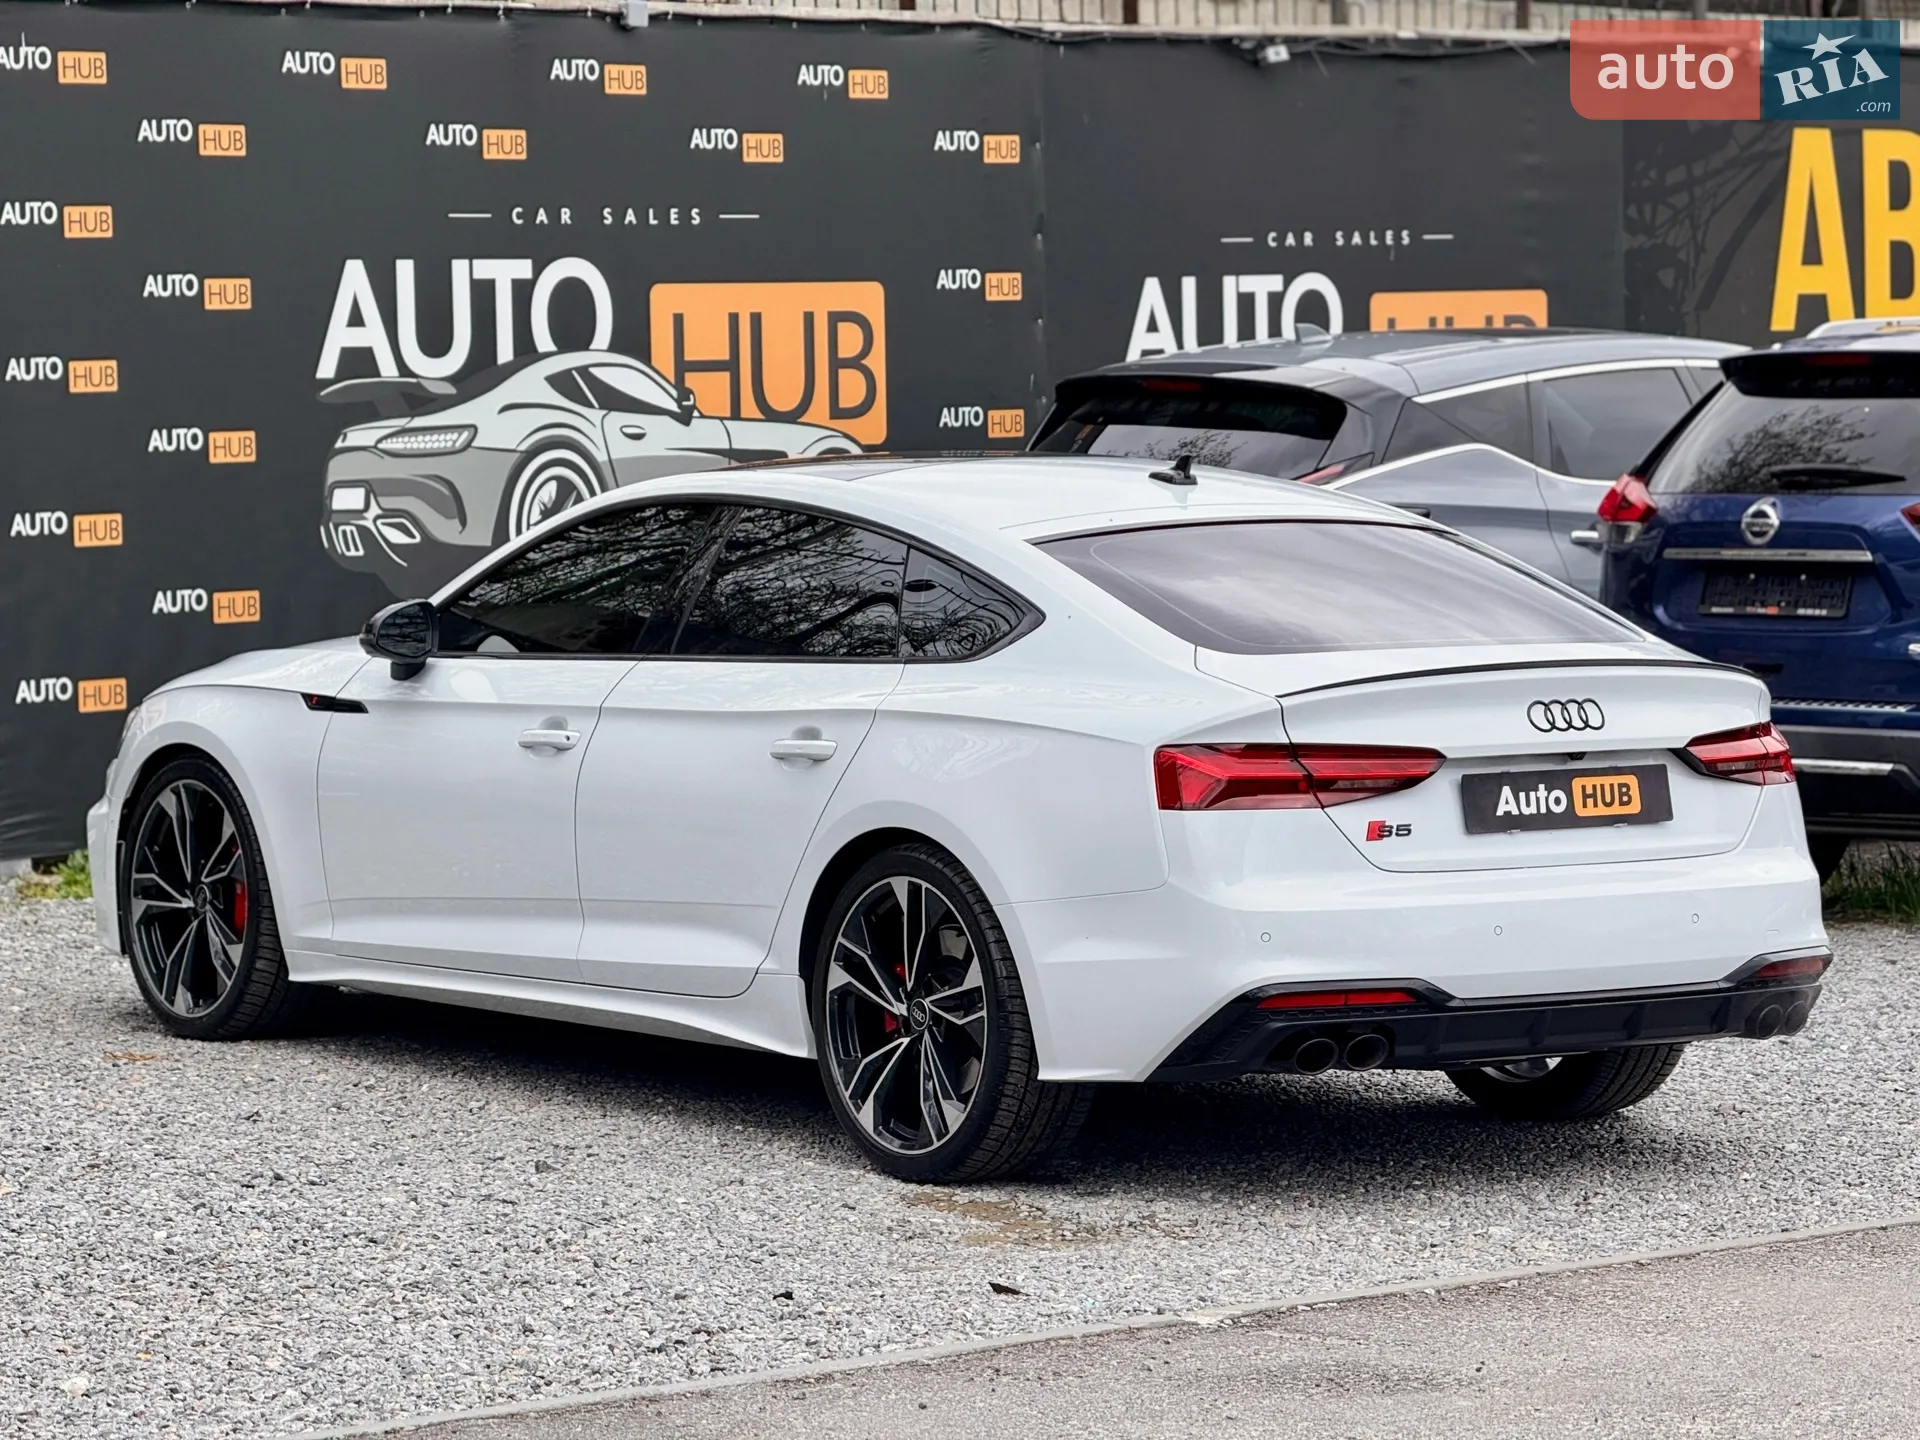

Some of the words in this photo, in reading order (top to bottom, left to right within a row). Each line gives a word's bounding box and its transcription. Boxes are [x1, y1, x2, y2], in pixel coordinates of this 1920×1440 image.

[0, 45, 52, 70] AUTO
[61, 56, 105, 80] HUB
[282, 51, 335, 75] AUTO
[344, 62, 386, 86] HUB
[550, 59, 599, 81] AUTO
[607, 69, 645, 91] HUB
[797, 65, 844, 86] AUTO
[851, 74, 887, 95] HUB
[137, 119, 193, 143] AUTO
[202, 129, 245, 152] HUB
[426, 124, 477, 147] AUTO
[486, 134, 525, 156] HUB
[690, 128, 738, 150] AUTO
[745, 138, 782, 159] HUB
[934, 130, 979, 152] AUTO
[986, 140, 1018, 160] HUB
[1, 201, 57, 226] AUTO
[67, 210, 111, 234] HUB
[512, 207, 572, 225] CAR
[603, 207, 702, 225] SALES
[1267, 231, 1315, 248] CAR
[1335, 229, 1412, 246] SALES
[143, 274, 198, 298] AUTO
[207, 283, 250, 306] HUB
[936, 269, 981, 289] AUTO
[988, 277, 1020, 297] HUB
[1125, 272, 1344, 362] AUTO
[315, 256, 613, 380] AUTO
[671, 309, 879, 421] HUB
[5, 357, 63, 382] AUTO
[72, 365, 116, 389] HUB
[939, 406, 984, 427] AUTO
[991, 414, 1023, 434] HUB
[148, 428, 203, 453] AUTO
[212, 436, 254, 459] HUB
[10, 511, 68, 537] AUTO
[77, 519, 121, 543] HUB
[152, 589, 208, 614] AUTO
[216, 595, 258, 619] HUB
[15, 677, 73, 705] AUTO
[82, 683, 125, 708] HUB
[1496, 784, 1567, 816] Auto
[1581, 782, 1633, 809] HUB
[1376, 823, 1412, 838] S5
